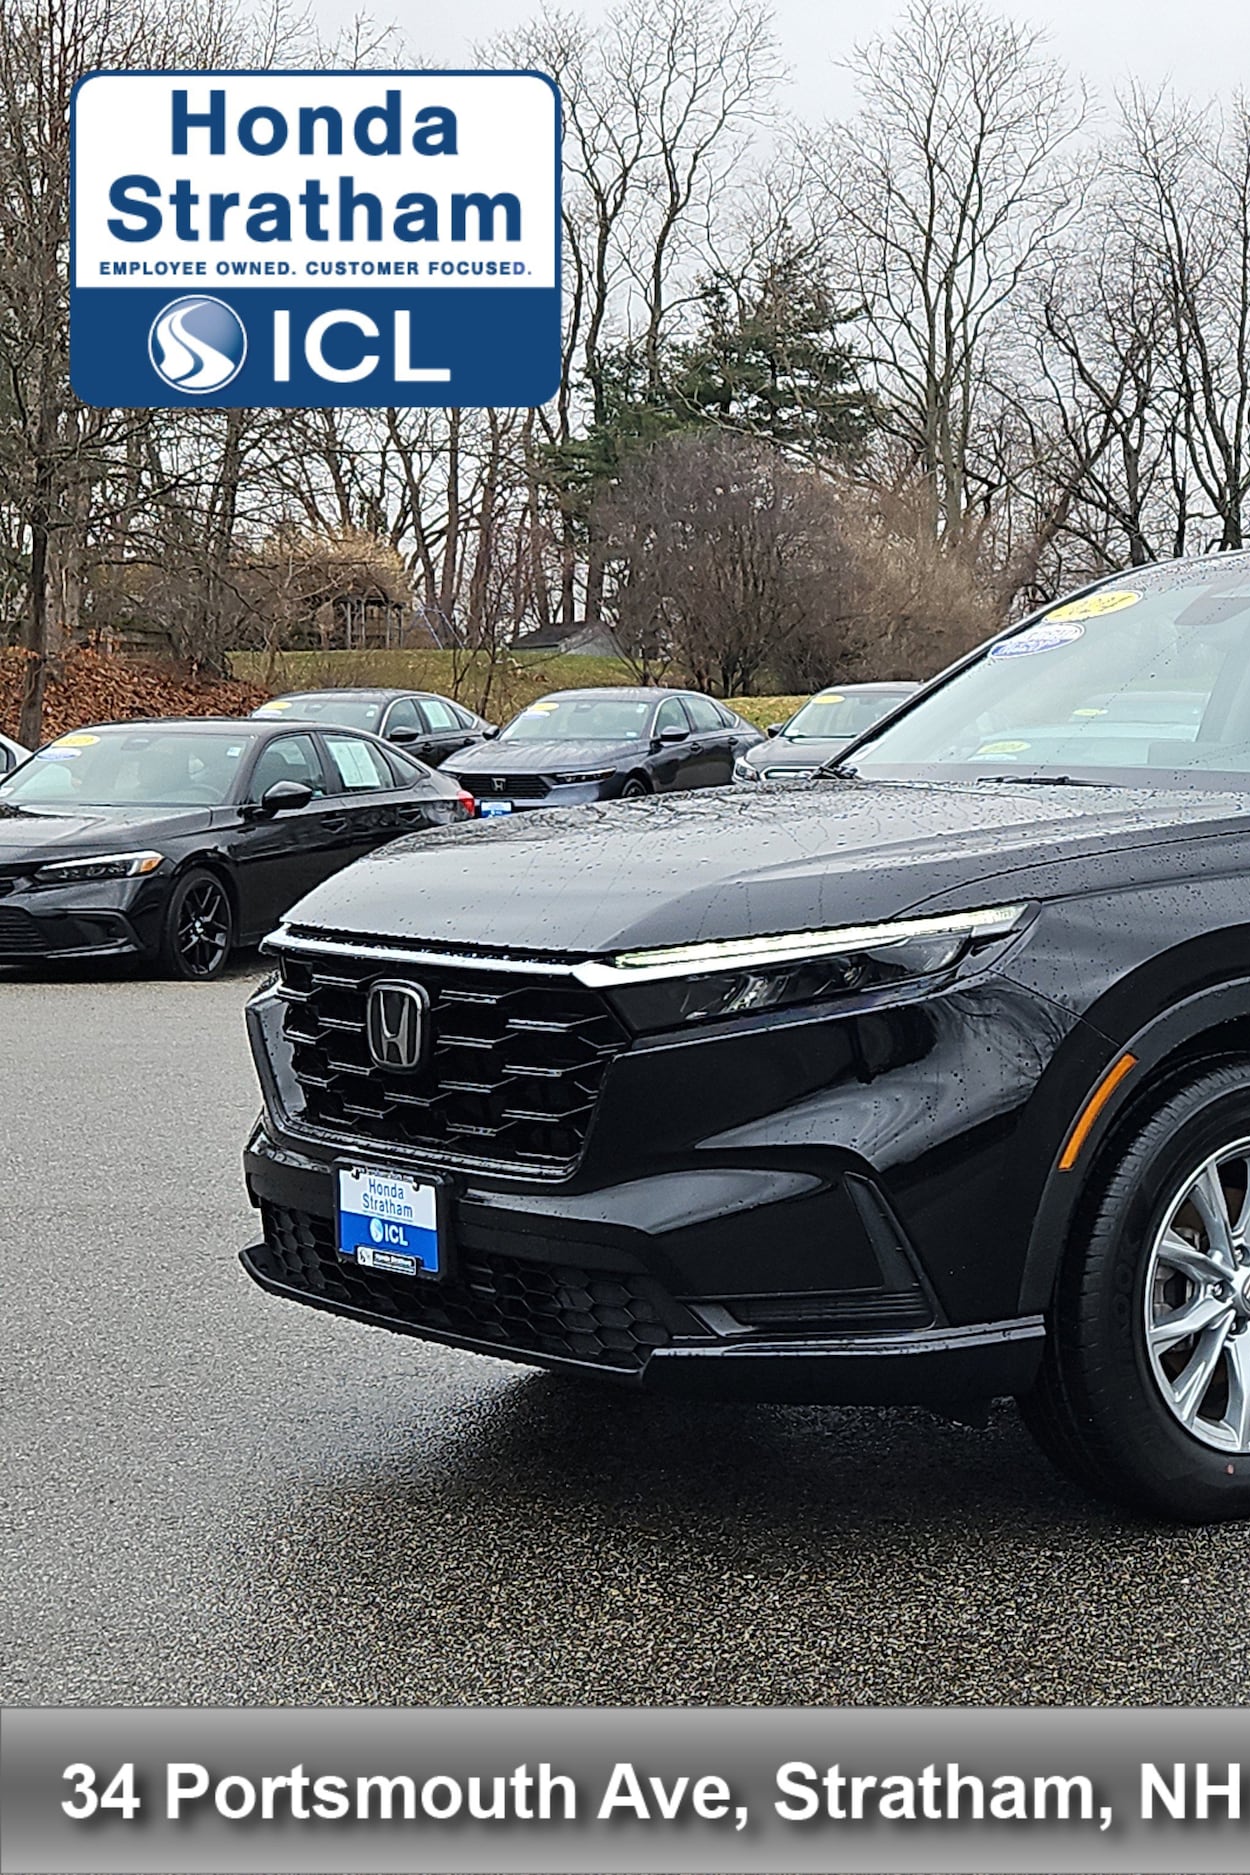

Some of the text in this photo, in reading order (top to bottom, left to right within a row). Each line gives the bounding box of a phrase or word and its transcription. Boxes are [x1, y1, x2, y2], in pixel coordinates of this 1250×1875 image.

[368, 1178, 404, 1200] Honda
[362, 1193, 413, 1218] Stratham
[384, 1223, 408, 1246] ICL
